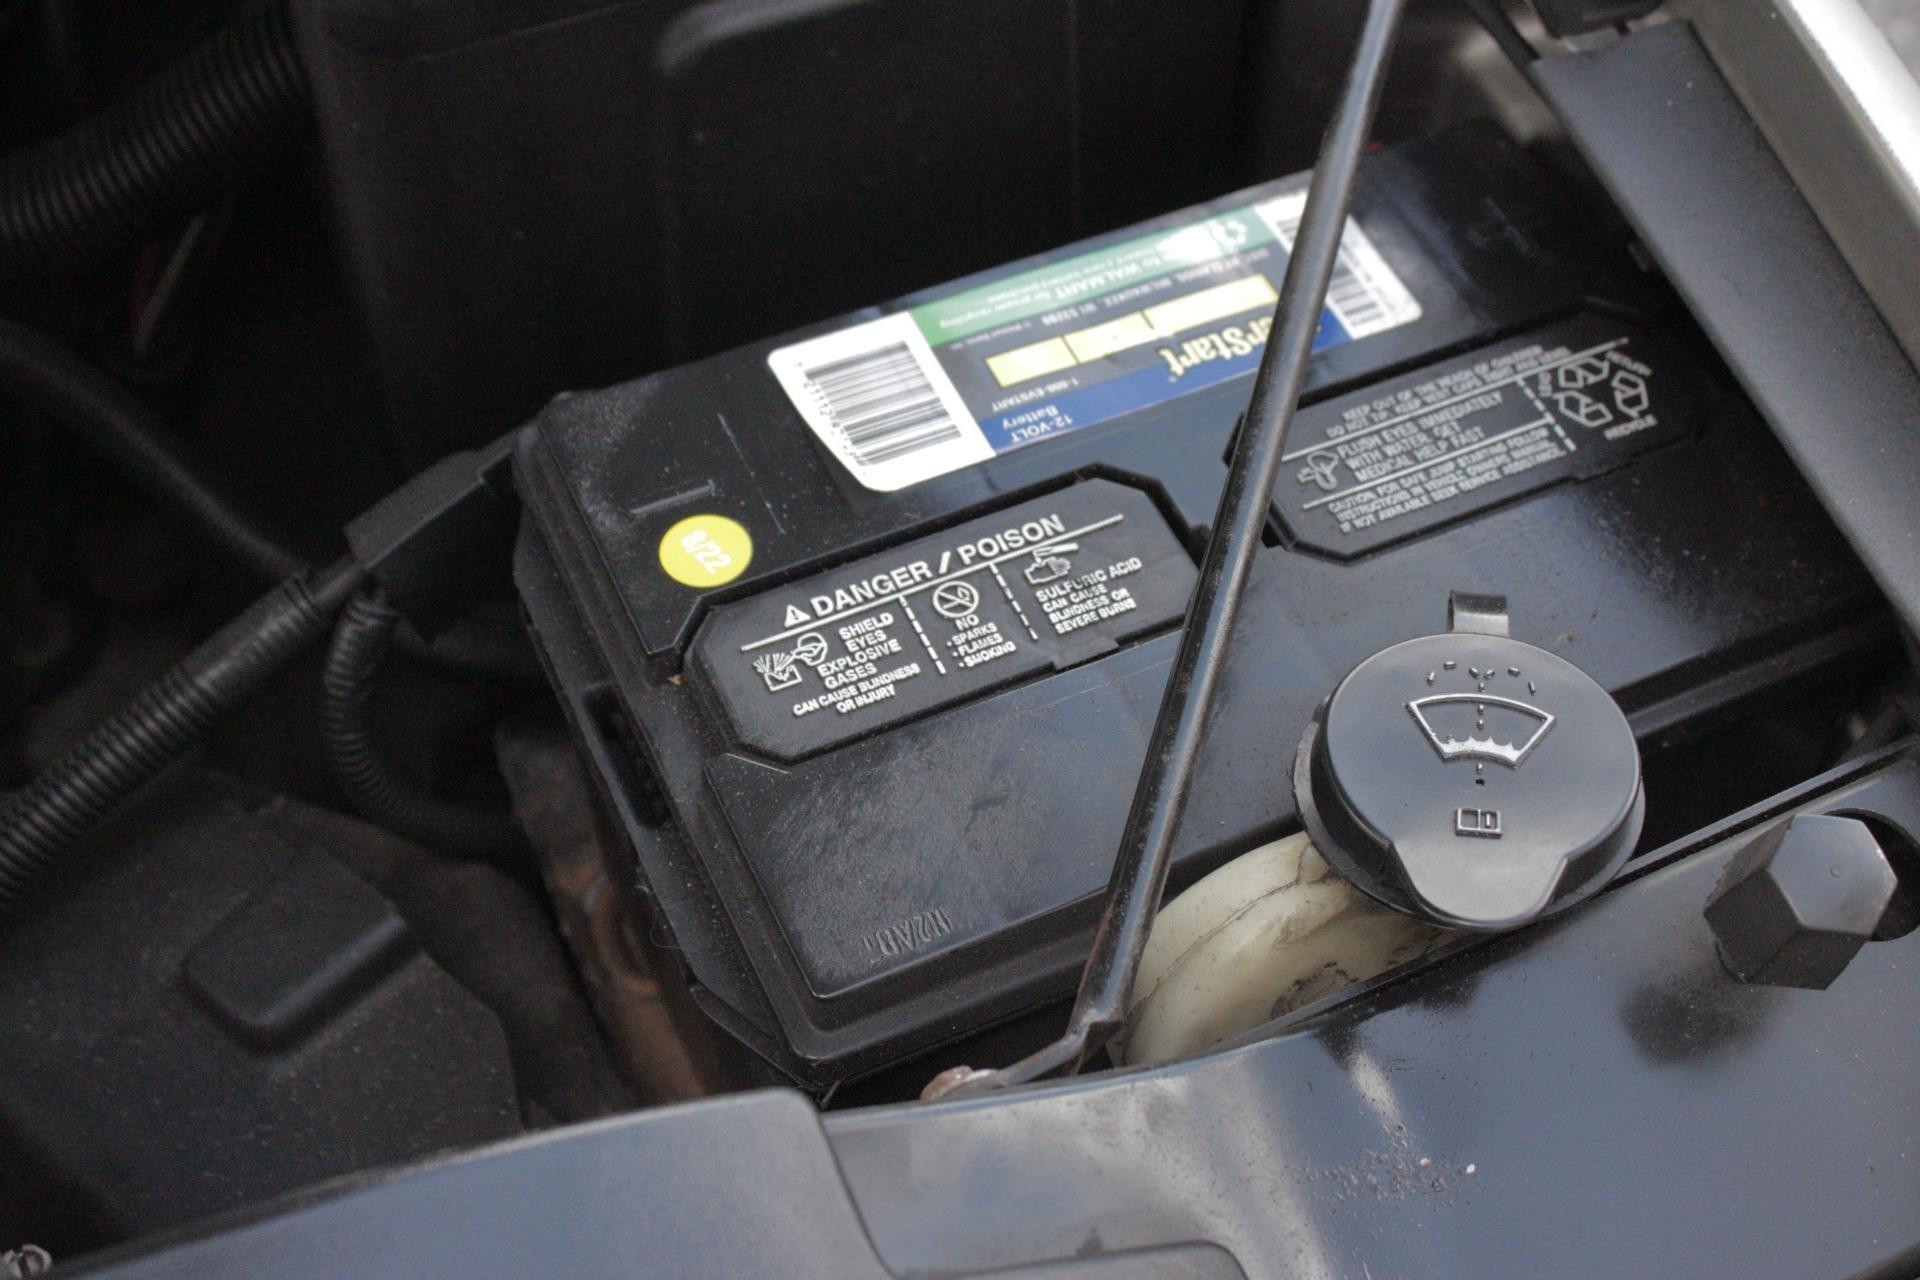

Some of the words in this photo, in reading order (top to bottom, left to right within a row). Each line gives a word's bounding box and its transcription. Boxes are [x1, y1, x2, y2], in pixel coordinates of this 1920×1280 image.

[1052, 262, 1142, 298] WALMART
[1156, 314, 1289, 378] rStart
[1395, 389, 1413, 402] OF
[999, 403, 1059, 429] Battery
[1006, 413, 1075, 442] 12-VOLT
[1325, 424, 1345, 438] DO
[1336, 433, 1383, 458] FLUSH
[1381, 420, 1420, 442] EYES
[1416, 390, 1505, 430] IMMEDIATELY
[1604, 414, 1658, 440] RECYCLE
[1344, 449, 1383, 470] WITH
[1432, 420, 1461, 439] GET
[1353, 452, 1415, 482] MEDICAL
[1412, 439, 1451, 461] HELP
[1448, 426, 1485, 448] FAST
[1376, 481, 1400, 495] FOR
[1399, 471, 1427, 487] SAFE
[1455, 442, 1509, 467] STARTING
[1506, 427, 1550, 448] FOLLOW
[1333, 490, 1412, 523] INSTRUCTIONS
[1410, 485, 1424, 496] IN
[1352, 513, 1376, 528] NOT
[1376, 494, 1431, 520] AVAILABLE
[1456, 468, 1502, 492] SERVICE
[681, 529, 732, 576] 8/22
[809, 559, 933, 617] DANGER
[956, 513, 1065, 565] POISON
[1034, 569, 1107, 602] SULFURIC
[1106, 557, 1143, 577] ACID
[1042, 597, 1068, 613] CAN
[1069, 583, 1107, 603] CAUSE
[1048, 595, 1110, 623] BLINDNESS
[1110, 587, 1130, 601] OR
[1054, 611, 1099, 633] SEVERE
[1098, 598, 1136, 618] BURNS
[837, 611, 894, 640] SHIELD
[951, 622, 997, 645] SPARKS
[954, 613, 980, 630] NO
[816, 639, 901, 677] EXPLOSIVE
[844, 629, 887, 652] EYES
[957, 633, 1003, 655] FLAMES
[963, 641, 1016, 667] SMOKING
[791, 699, 819, 716] CAN
[817, 685, 858, 706] CAUSE
[857, 662, 921, 692] BLINDNESS
[822, 662, 878, 689] GASES
[835, 699, 855, 713] OR
[853, 683, 897, 706] INJURY
